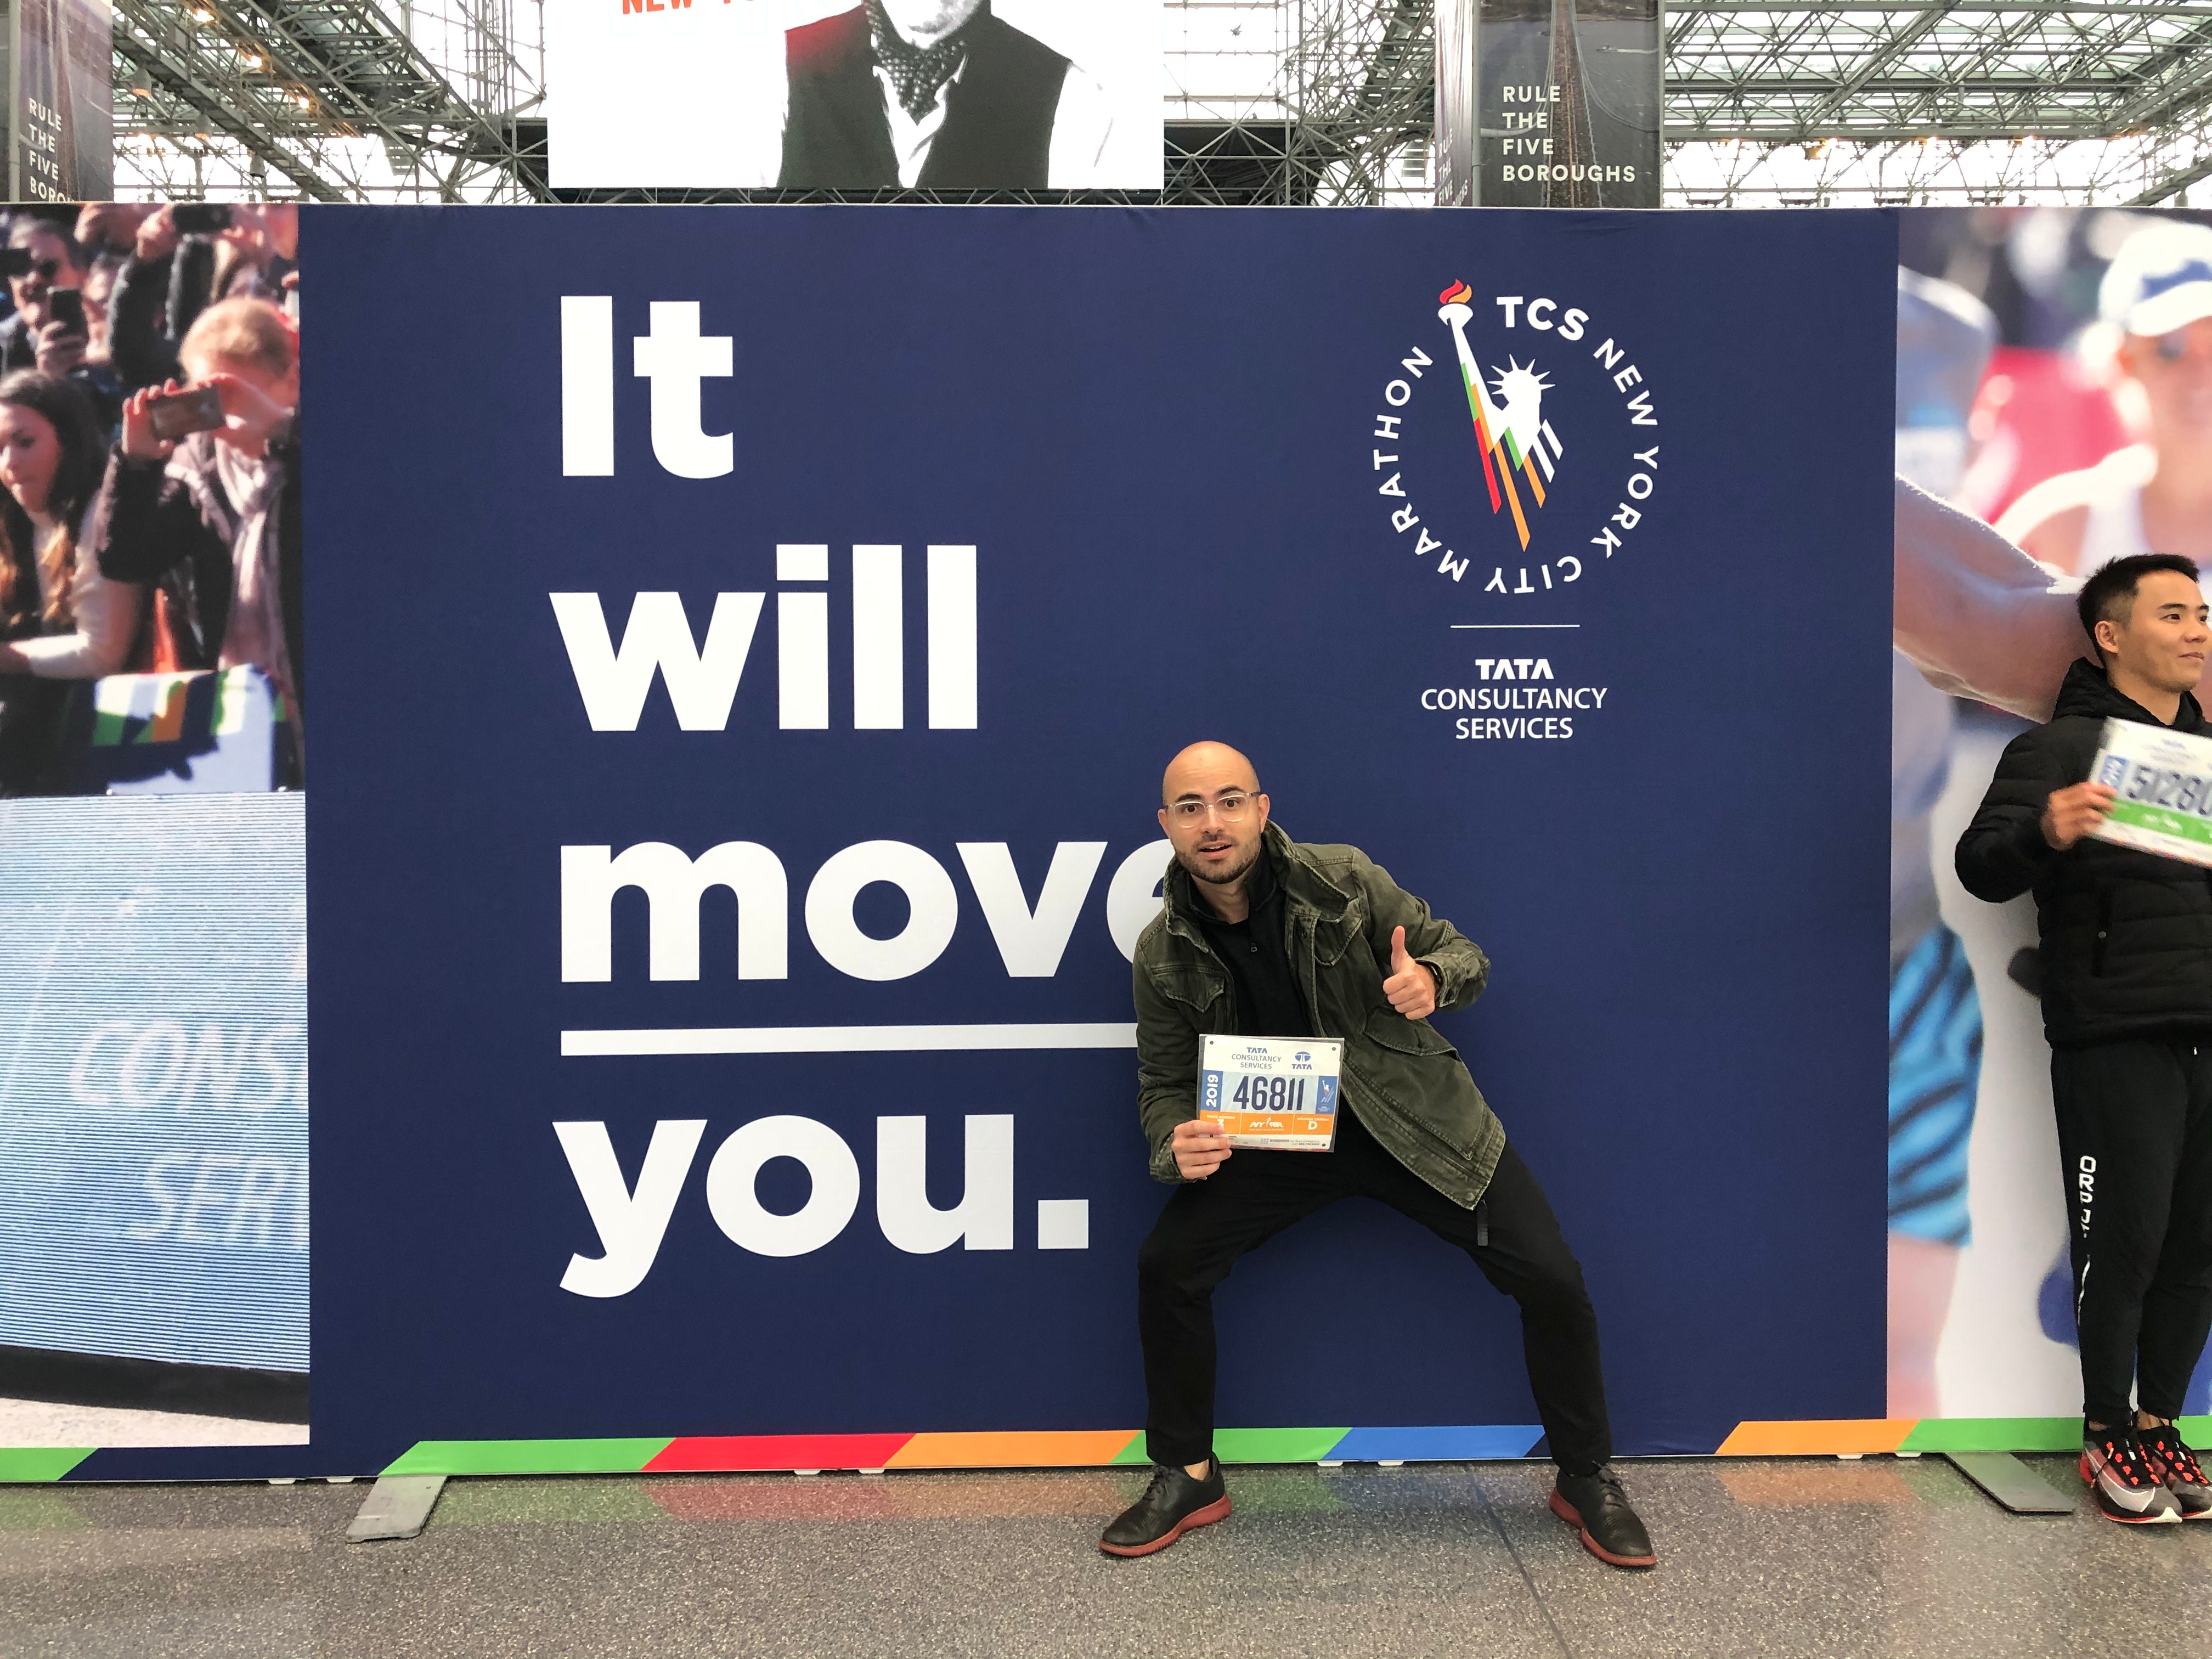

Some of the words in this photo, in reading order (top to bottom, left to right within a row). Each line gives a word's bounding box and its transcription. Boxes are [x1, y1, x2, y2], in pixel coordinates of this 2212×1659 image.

[1503, 86, 1561, 103] RULE
[29, 97, 62, 132] RULE
[1502, 112, 1548, 129] THE
[29, 123, 55, 153] THE
[1503, 138, 1554, 155] FIVE
[29, 150, 59, 181] FIVE
[1503, 165, 1636, 182] BOROUGHS
[1497, 296, 1589, 341] TCS
[561, 296, 733, 479] It
[1593, 338, 1658, 425] NEW
[1373, 346, 1470, 582] MARATHON
[1590, 445, 1659, 558] YORK
[1484, 556, 1582, 594] CITY
[549, 544, 978, 731] will
[1475, 659, 1554, 680] TATA
[1421, 688, 1608, 710] CONSULTANCY
[1455, 718, 1573, 740] SERVICES
[1231, 1054, 1282, 1063] CONSULTANCY
[1206, 1074, 1219, 1108] 2019
[1233, 1076, 1305, 1111] 46811
[1308, 1121, 1318, 1130] D
[552, 1114, 1089, 1298] you.
